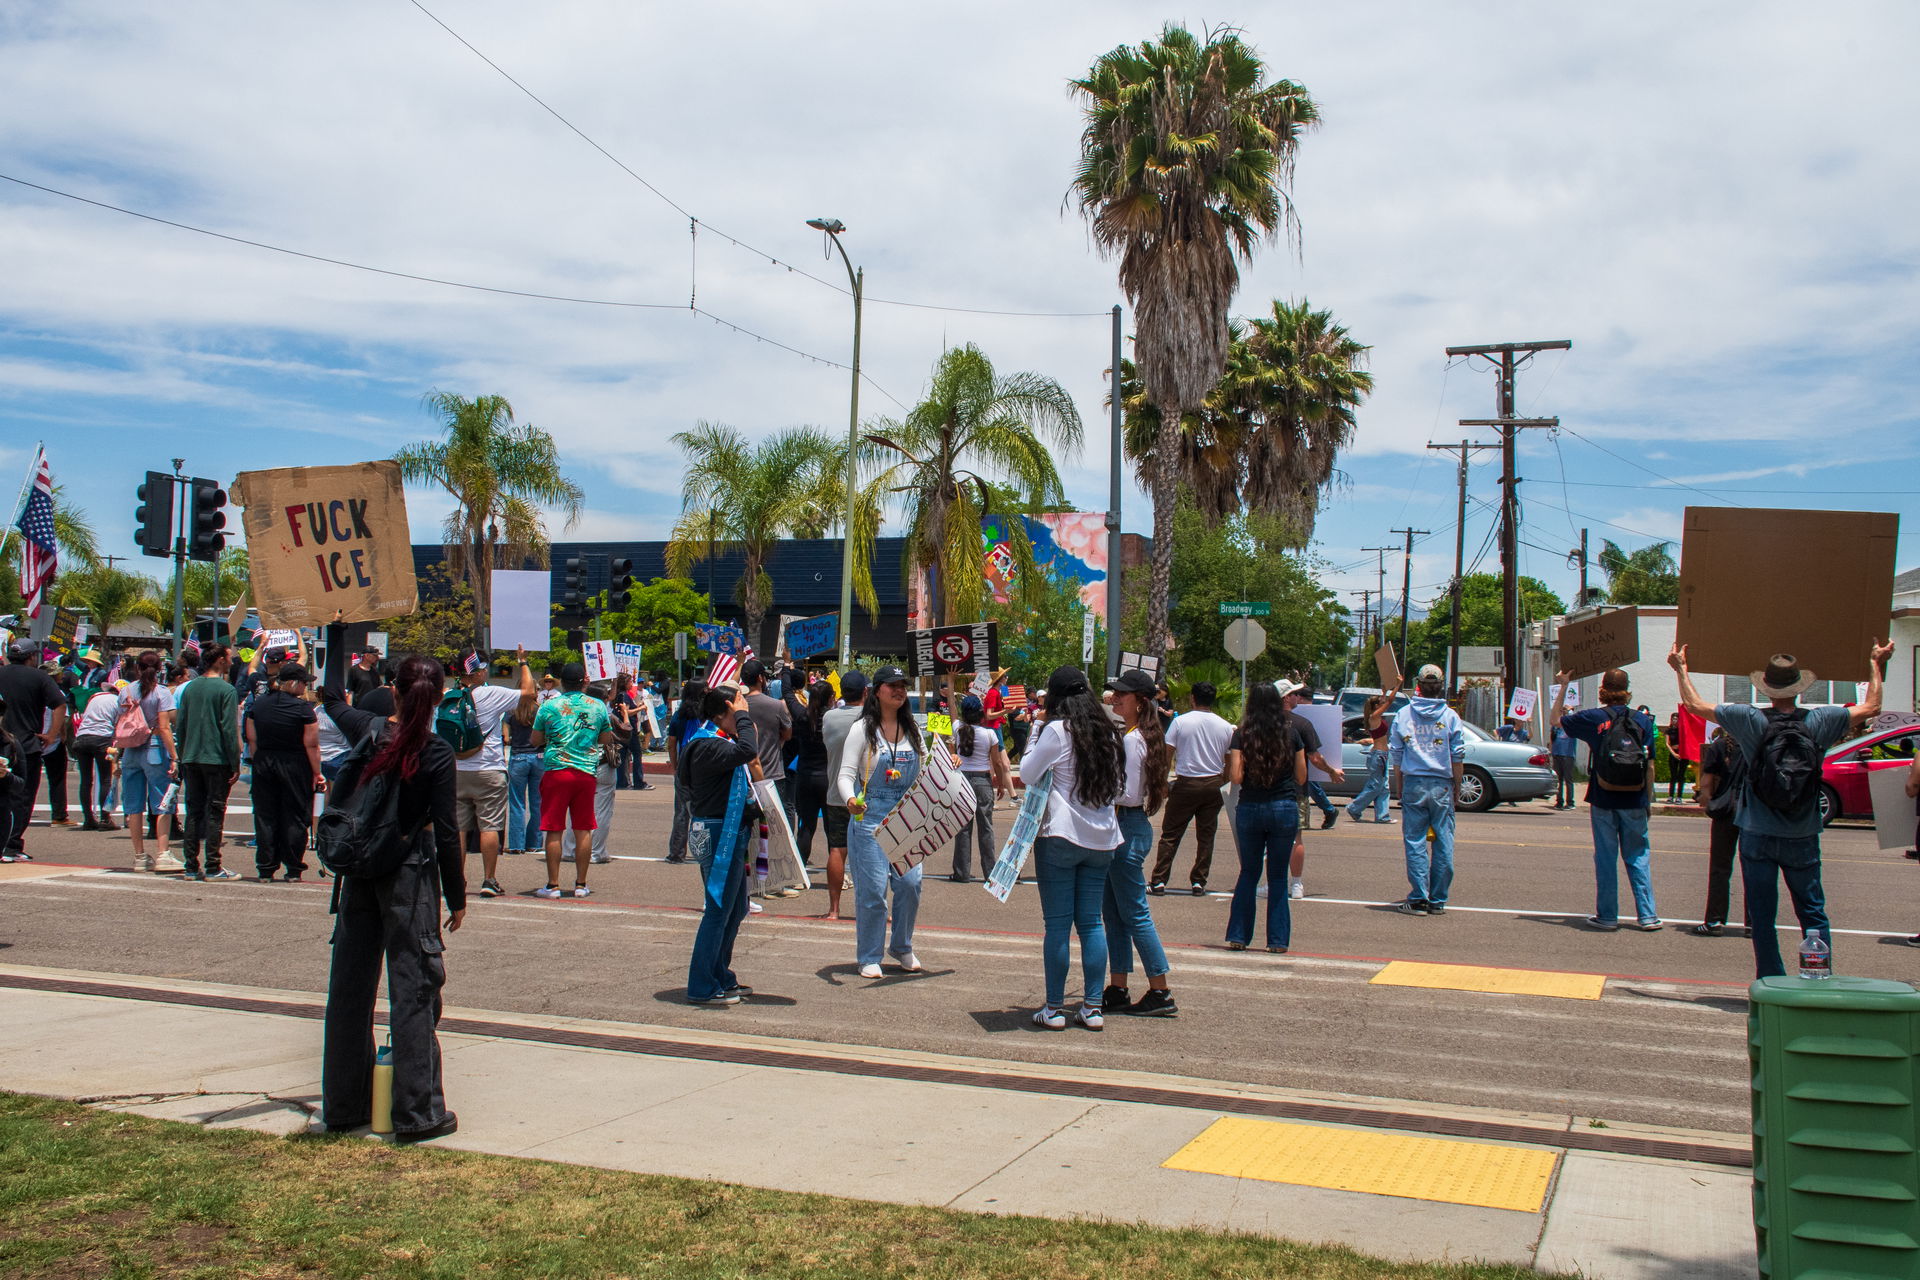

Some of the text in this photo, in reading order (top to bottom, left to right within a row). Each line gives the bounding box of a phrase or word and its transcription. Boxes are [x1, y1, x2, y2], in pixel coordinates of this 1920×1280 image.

[285, 499, 373, 548] FUCK
[315, 549, 372, 593] ICE
[1220, 603, 1253, 615] Broadway
[971, 623, 988, 638] NO
[1584, 622, 1602, 635] NO
[270, 635, 294, 645] TRUMP
[942, 635, 963, 660] ICE
[1572, 631, 1615, 653] HUMAN
[615, 643, 641, 657] ICE
[972, 639, 990, 673] HUMAN
[1406, 720, 1442, 735] Save
